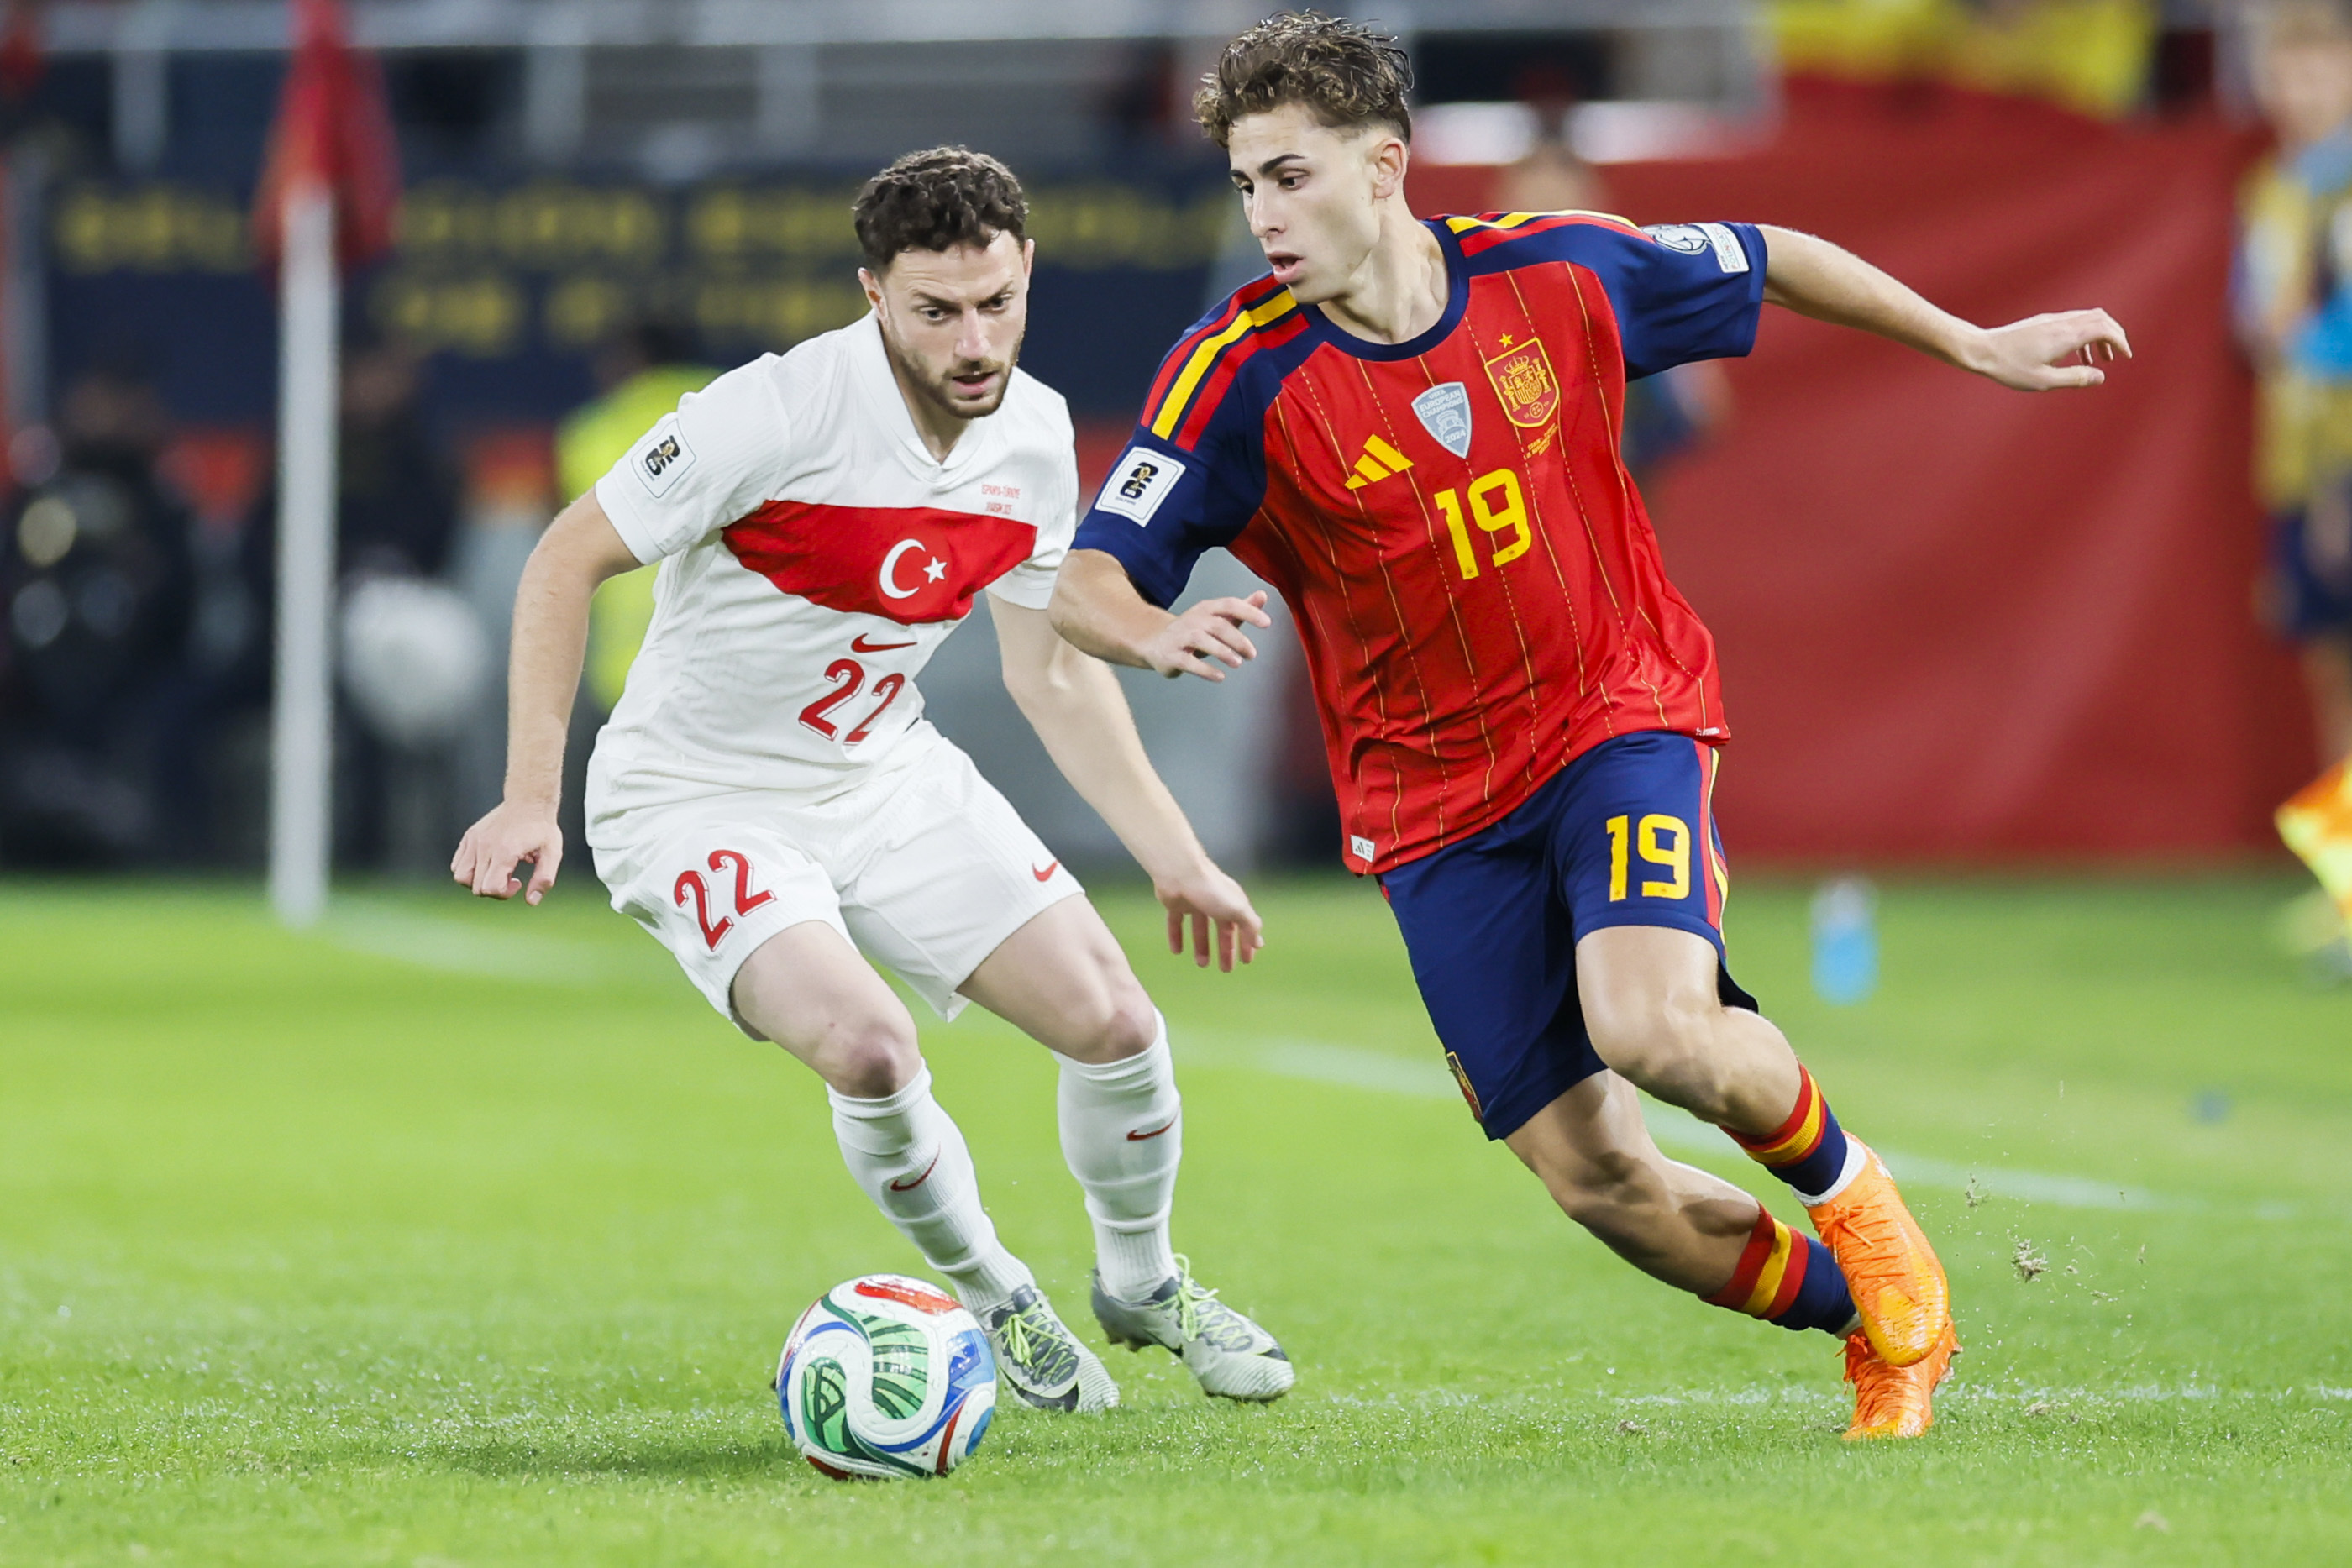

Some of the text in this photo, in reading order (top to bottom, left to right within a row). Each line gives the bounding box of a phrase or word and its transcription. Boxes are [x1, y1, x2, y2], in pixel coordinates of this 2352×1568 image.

[1418, 389, 1462, 412] EUROPEAN
[1421, 397, 1464, 419] CHAMPIONS
[1428, 389, 1446, 400] UEFA
[1445, 428, 1467, 444] 2024
[1433, 468, 1531, 580] 19
[798, 658, 906, 746] 22
[1605, 813, 1691, 902] 19
[674, 848, 778, 952] 22
